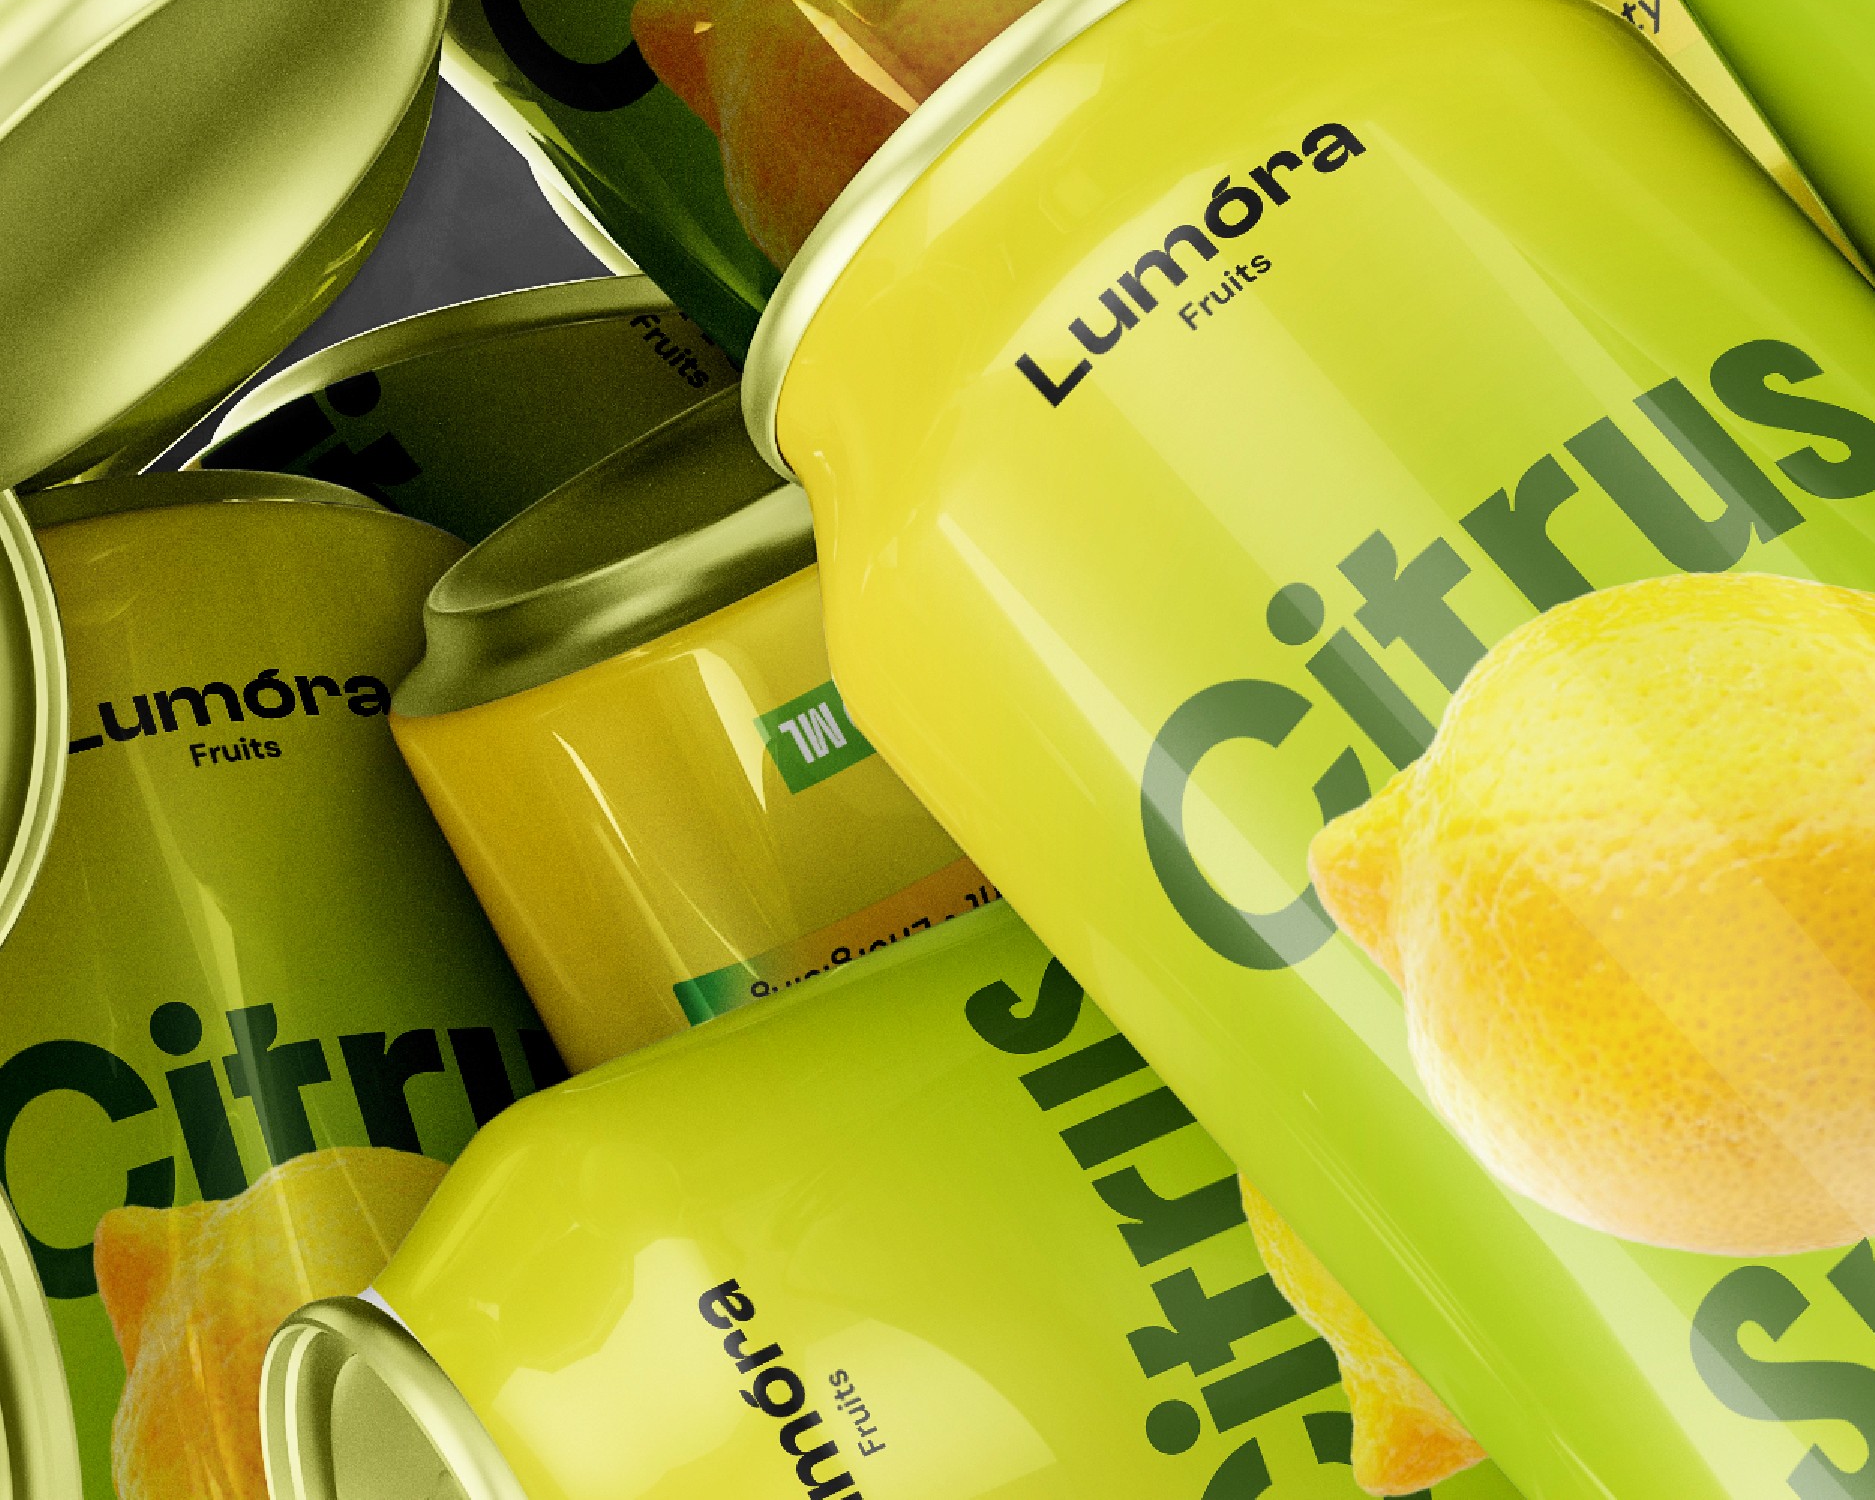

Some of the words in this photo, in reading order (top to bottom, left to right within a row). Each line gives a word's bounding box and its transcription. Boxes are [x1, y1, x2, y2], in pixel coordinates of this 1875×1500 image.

[1014, 121, 1366, 408] Lumóra
[1178, 252, 1272, 332] Fruits
[189, 736, 283, 768] Fruits
[779, 701, 848, 766] ML
[699, 1278, 866, 1500] móra
[827, 1368, 887, 1459] Fruits
